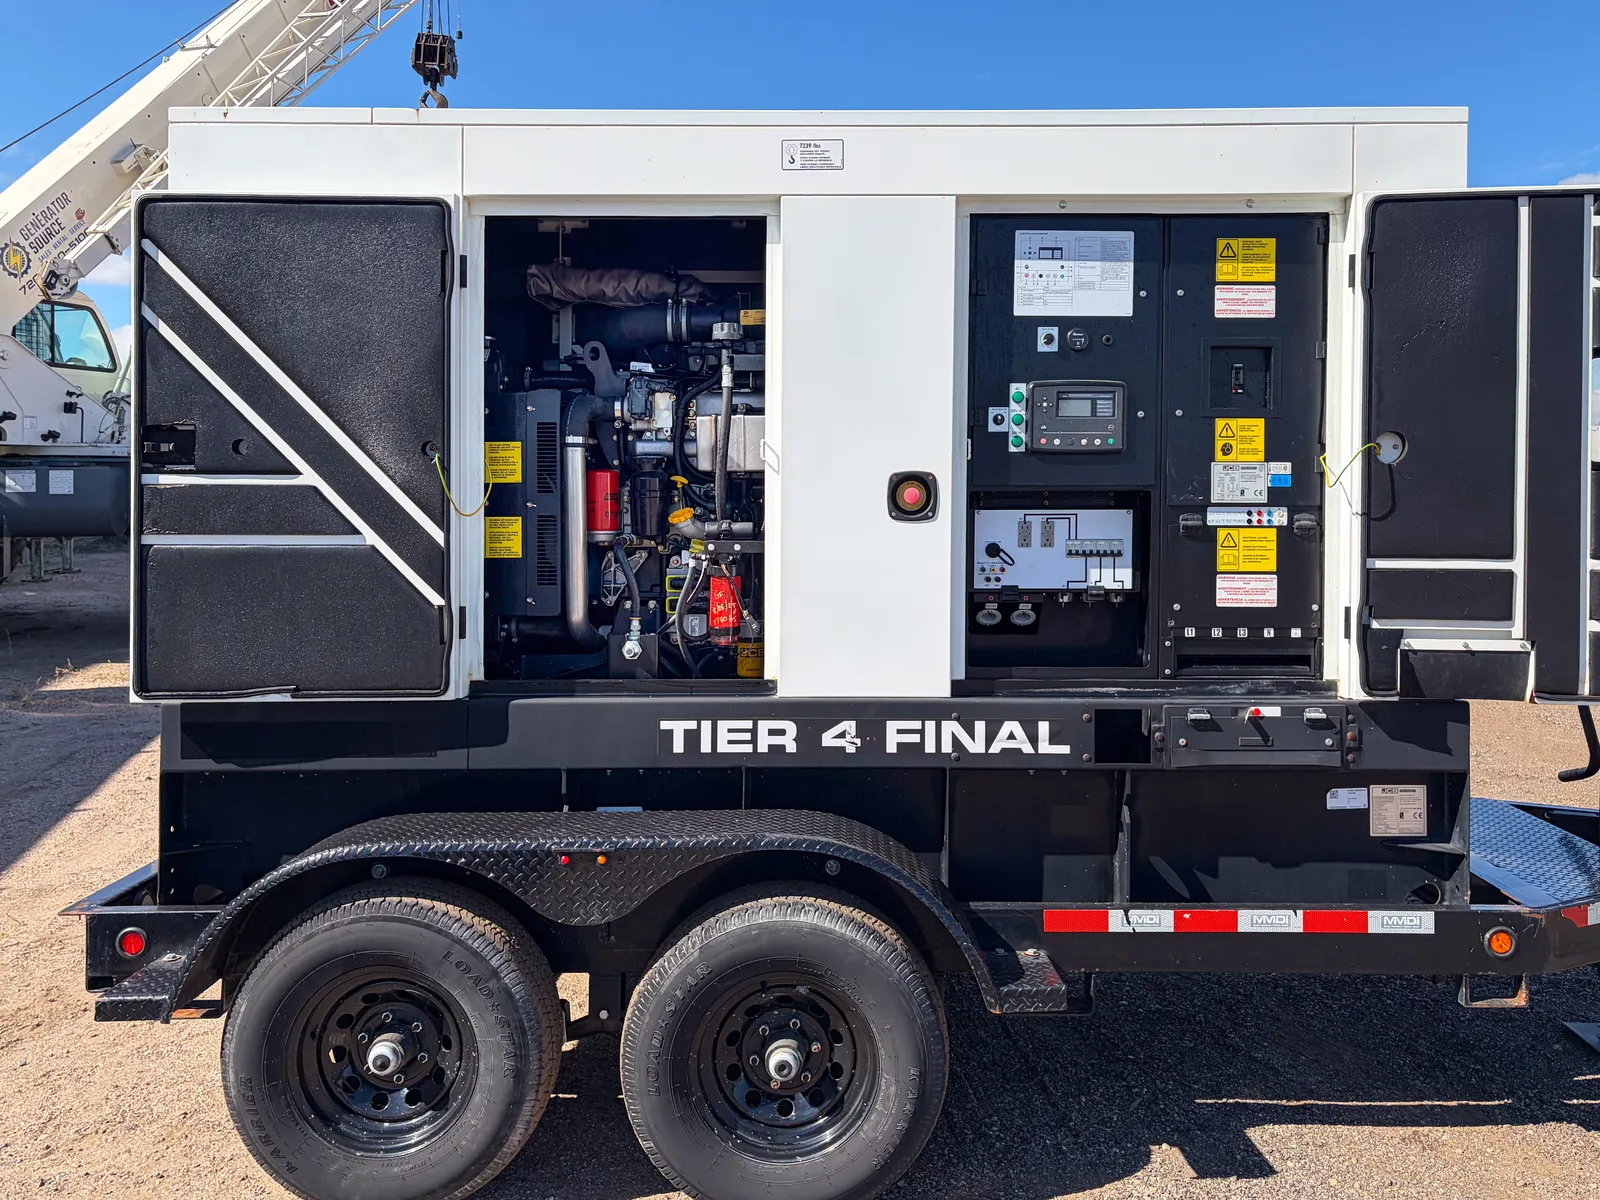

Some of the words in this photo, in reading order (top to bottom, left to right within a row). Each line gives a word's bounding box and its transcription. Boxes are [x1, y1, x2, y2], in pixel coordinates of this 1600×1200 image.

[19, 191, 72, 241] GENERATOR
[28, 217, 66, 254] SOURCE
[1187, 628, 1194, 636] L1
[659, 720, 798, 754] TIER
[821, 720, 861, 754] 4
[886, 720, 1071, 755] FINAL
[440, 950, 495, 1000] LOAD
[494, 1014, 516, 1079] STAR
[645, 1030, 664, 1097] LOAD
[665, 961, 713, 1018] STAR
[240, 1075, 299, 1175] KARRIER
[872, 1067, 923, 1170] KARRIER
